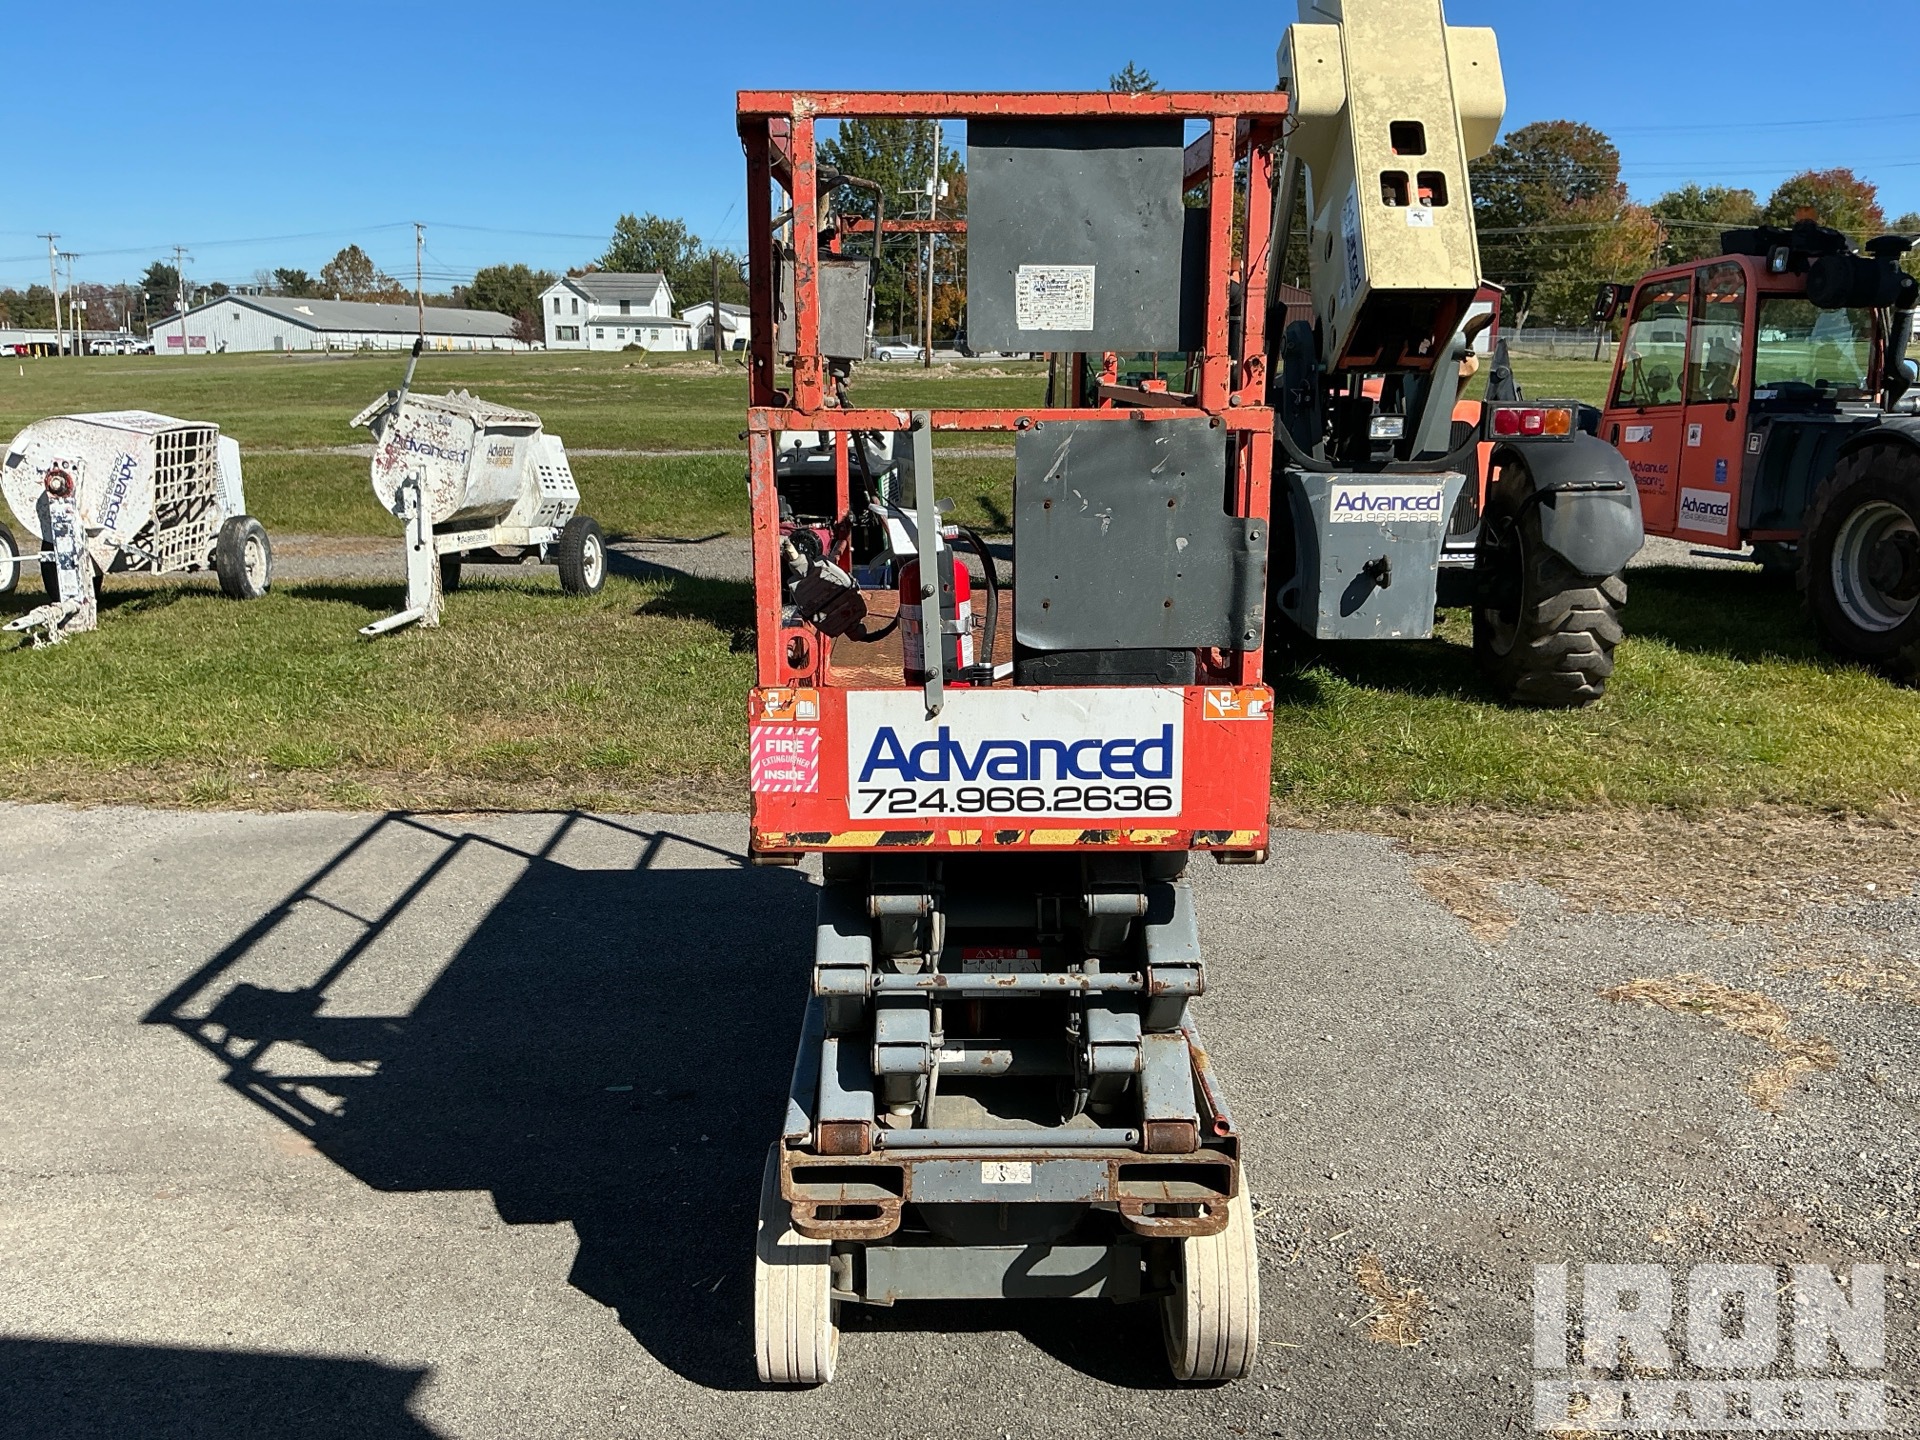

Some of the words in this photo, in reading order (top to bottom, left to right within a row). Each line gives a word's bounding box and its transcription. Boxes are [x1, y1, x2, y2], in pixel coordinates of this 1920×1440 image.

[104, 453, 138, 530] Advanced
[1334, 491, 1441, 511] Advanced
[1681, 496, 1729, 516] Advanced
[1333, 512, 1440, 522] 724.966.2636
[765, 739, 805, 753] FIRE
[858, 724, 1173, 782] Advanced
[764, 770, 806, 780] INSIDE
[857, 785, 1172, 814] 724.966.2636
